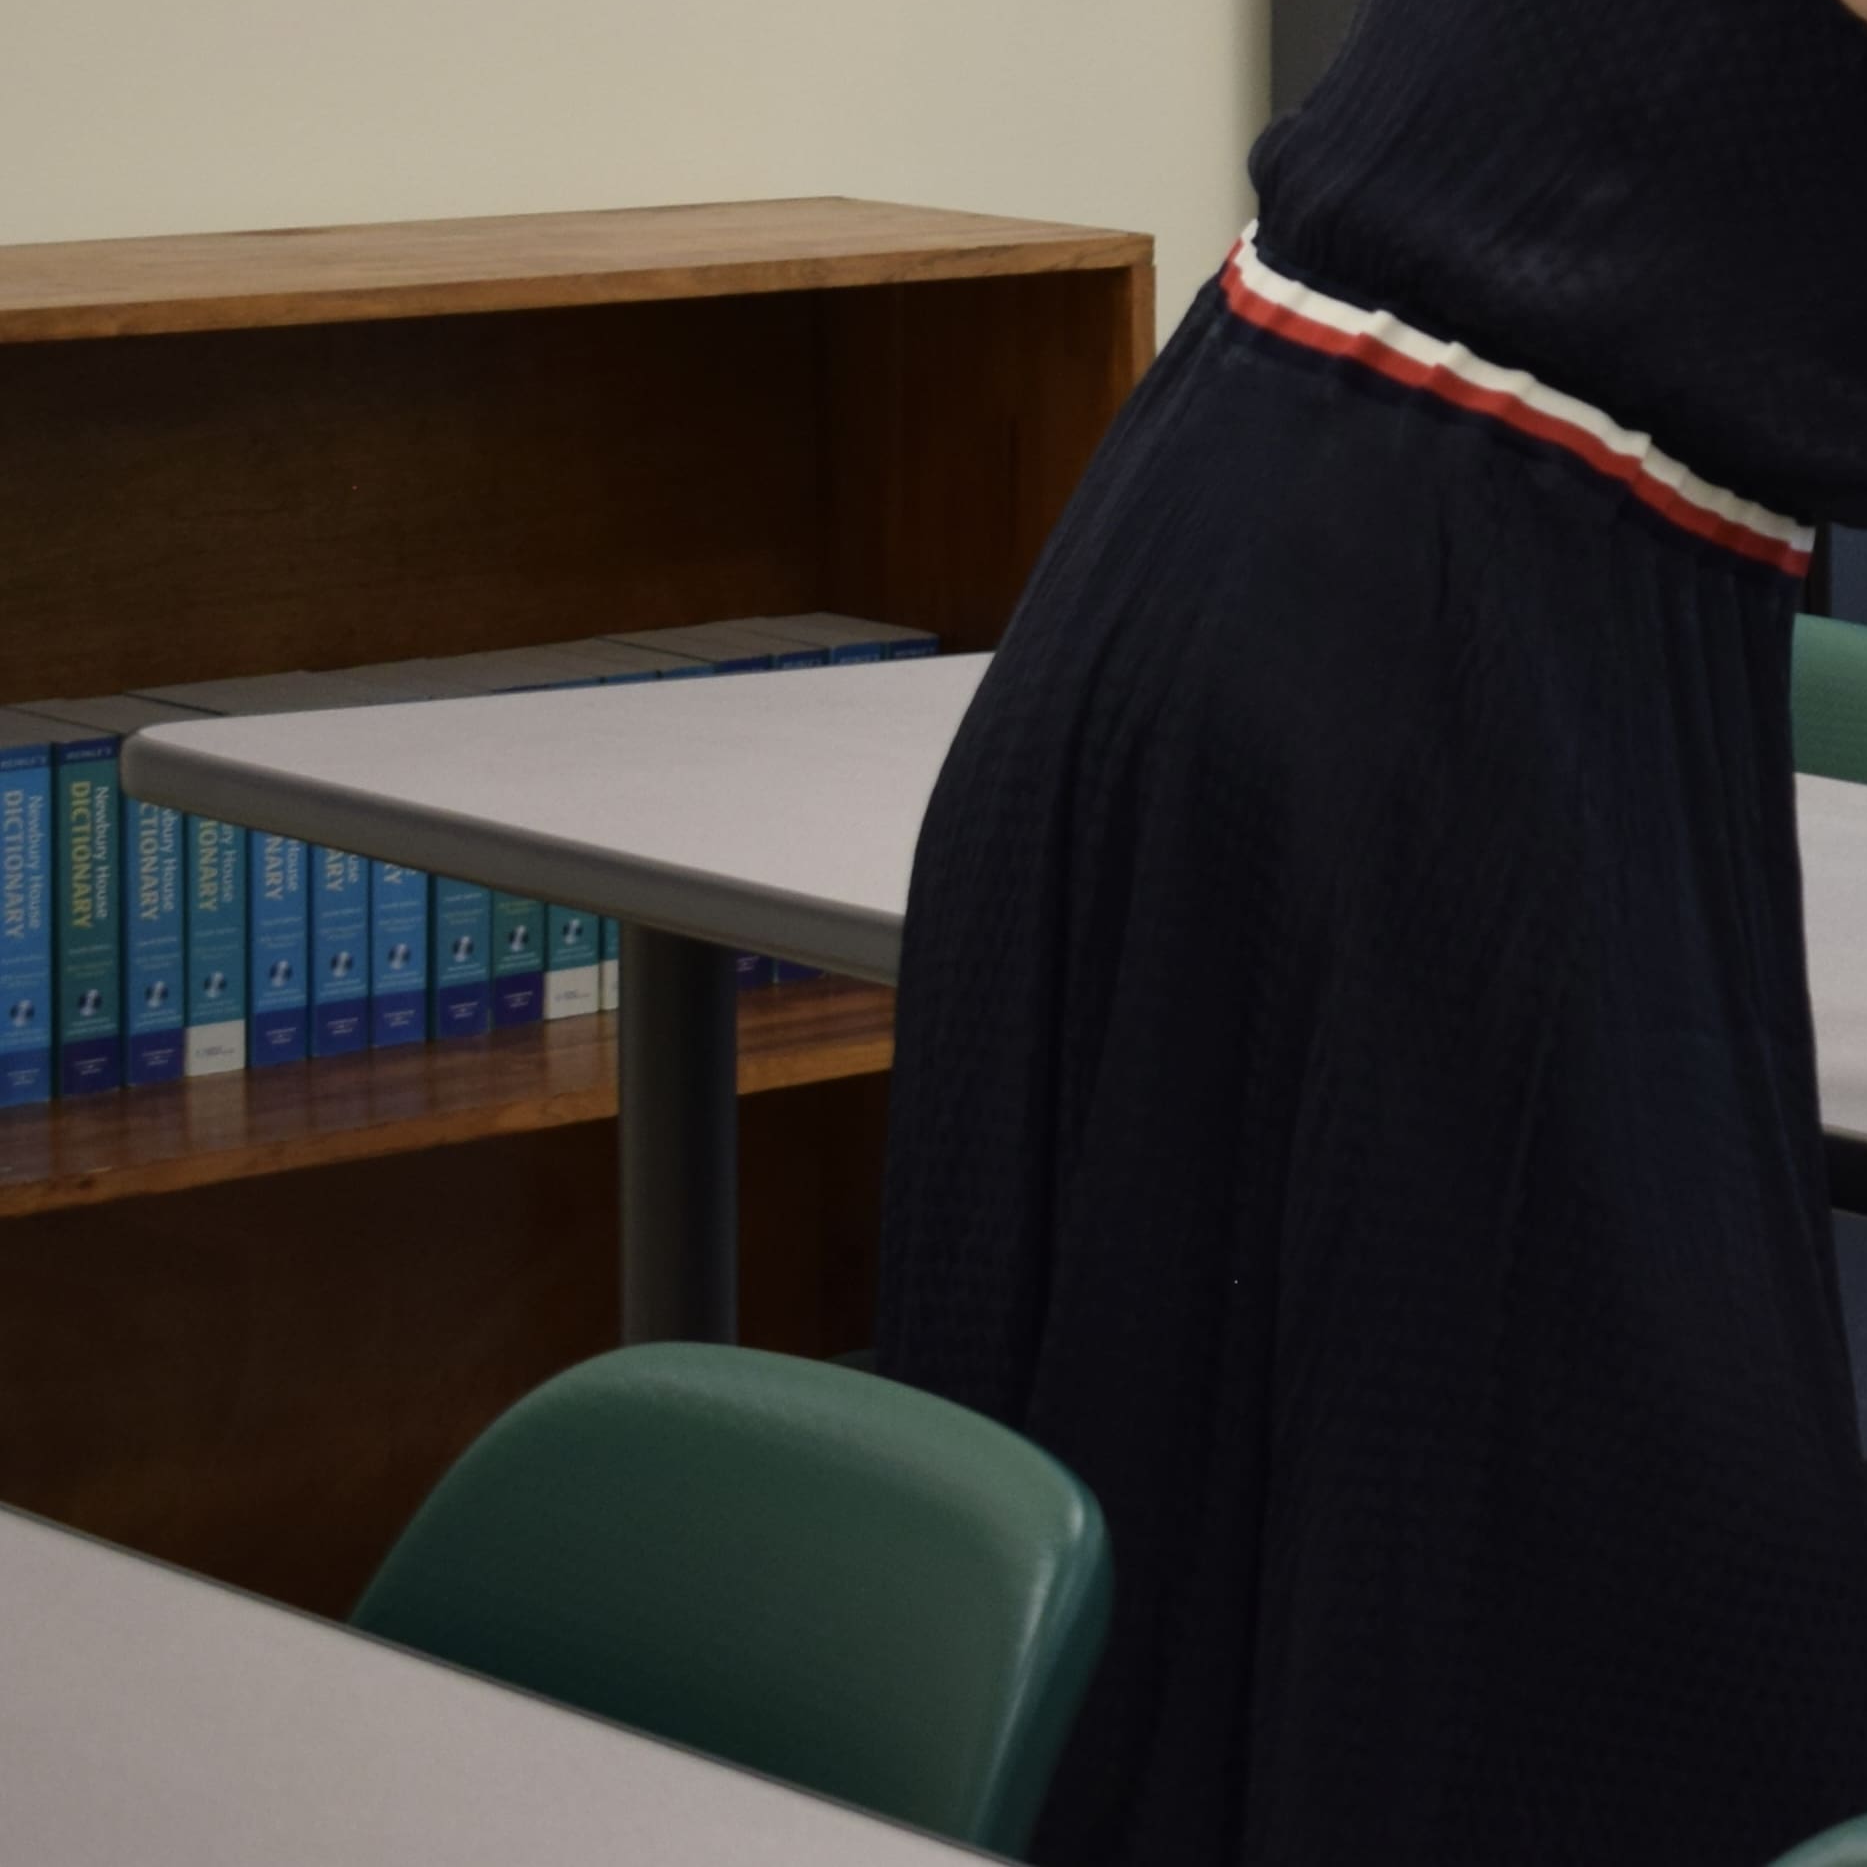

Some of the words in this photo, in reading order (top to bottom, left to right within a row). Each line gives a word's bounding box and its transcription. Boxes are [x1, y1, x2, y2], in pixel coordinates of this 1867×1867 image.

[27, 794, 44, 871] Newbury
[70, 780, 94, 930] DICTIONARY
[93, 785, 111, 862] Newbury
[160, 806, 179, 853] bury
[3, 788, 26, 940] DICTIONARY
[95, 865, 110, 920] House
[139, 801, 160, 921] CTIONARY
[162, 857, 178, 911] House
[198, 820, 219, 912] IONARY
[222, 849, 238, 903] House
[347, 853, 361, 884] use
[28, 874, 43, 930] House
